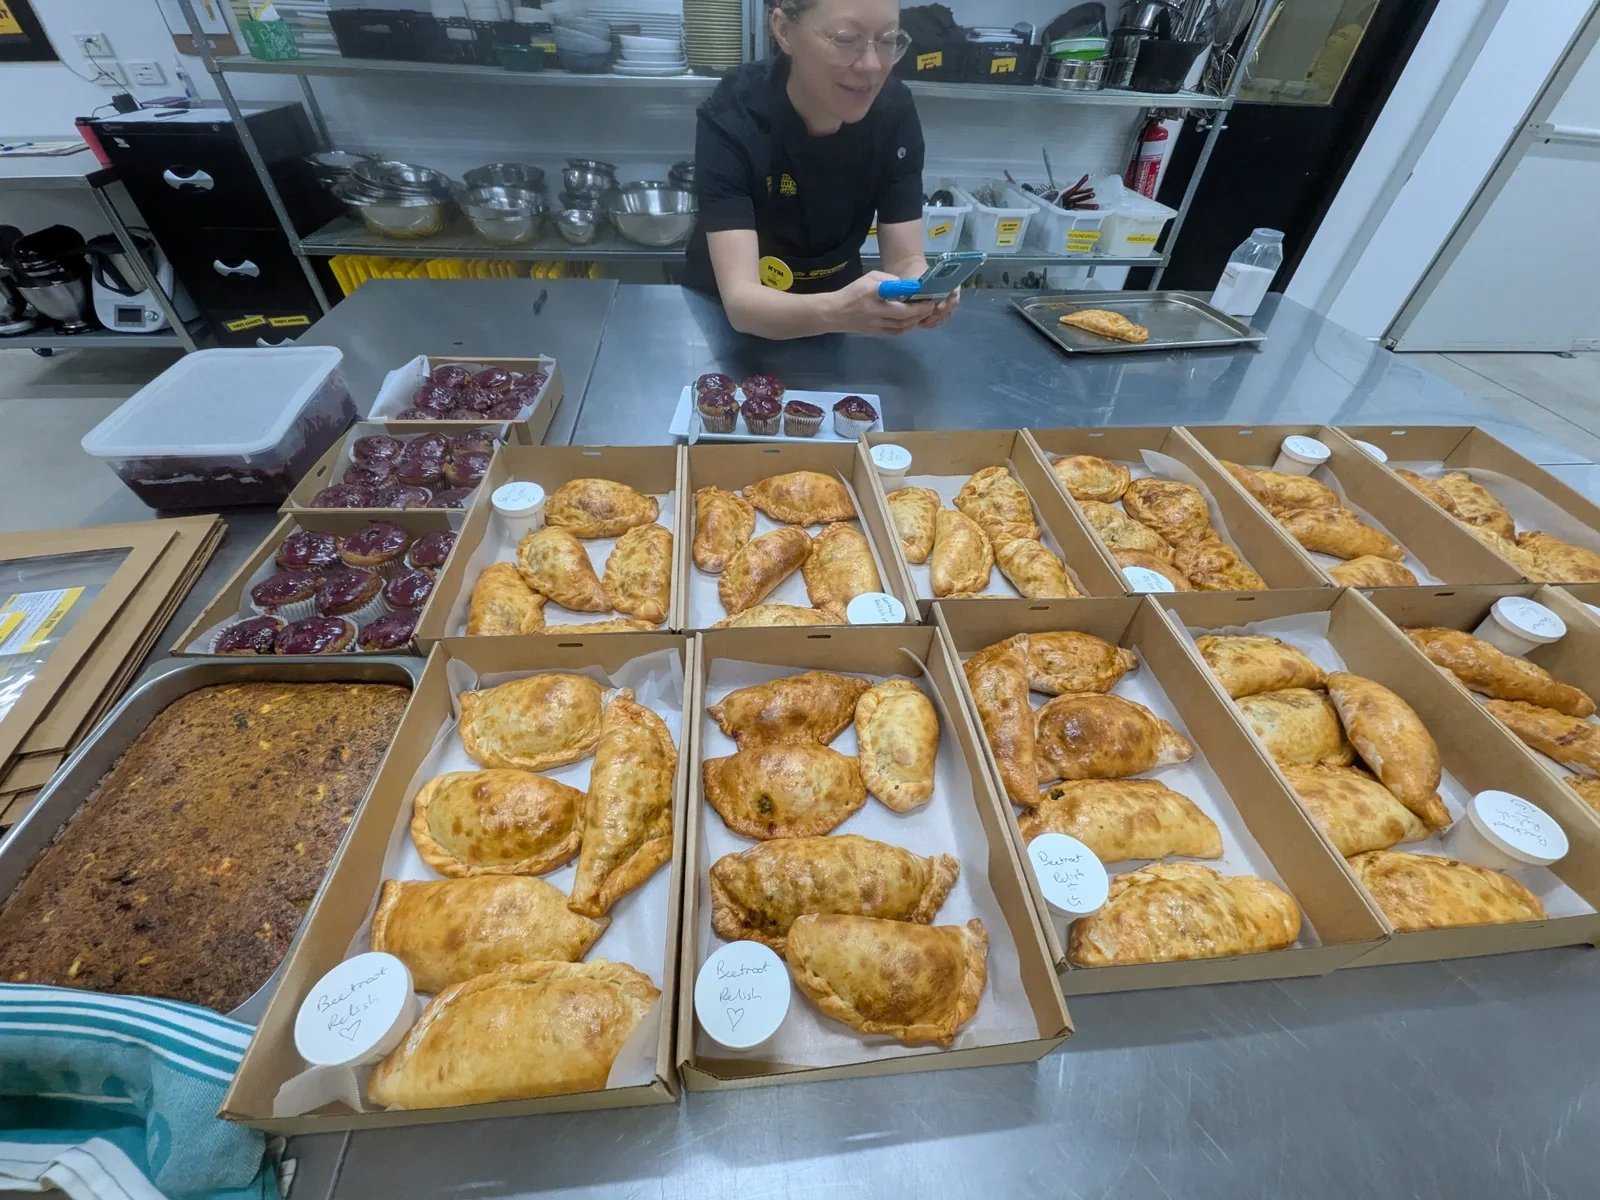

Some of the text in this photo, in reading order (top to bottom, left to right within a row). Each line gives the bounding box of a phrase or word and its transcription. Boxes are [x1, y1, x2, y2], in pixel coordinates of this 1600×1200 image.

[767, 264, 784, 277] KYM
[1037, 850, 1083, 867] Beetroot
[716, 959, 771, 980] Beetroot
[317, 966, 388, 1013] Beetroot
[719, 986, 762, 1002] Relish
[327, 993, 380, 1031] Relish
